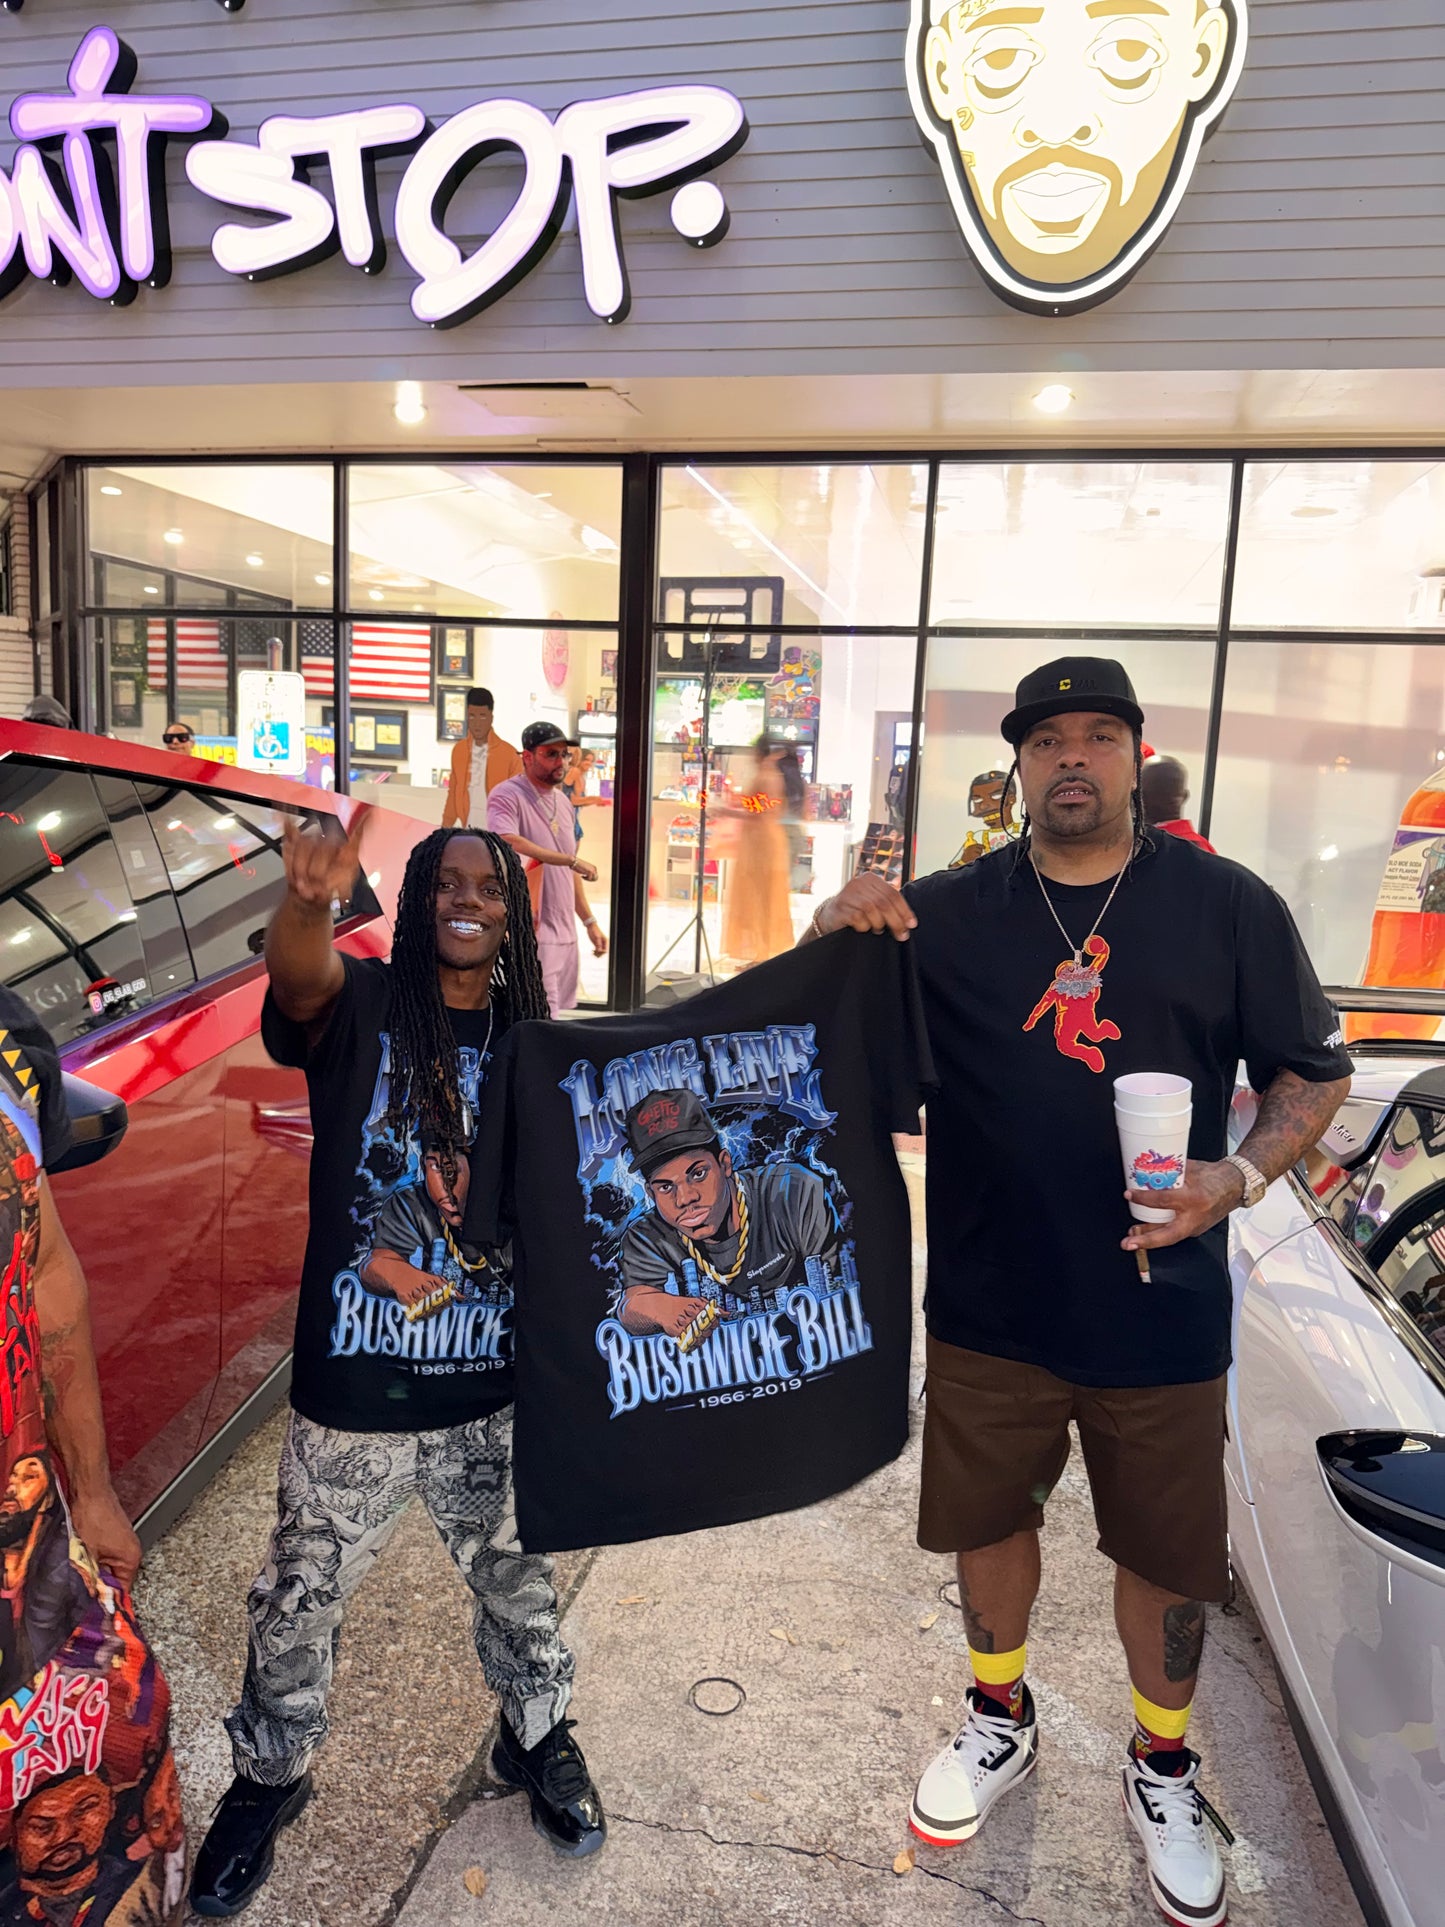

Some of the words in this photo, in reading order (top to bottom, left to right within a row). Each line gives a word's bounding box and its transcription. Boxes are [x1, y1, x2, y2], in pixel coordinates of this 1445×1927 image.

[185, 84, 746, 322] STOP.
[558, 1037, 708, 1181] LONG
[703, 1023, 838, 1130] LIVE
[637, 1099, 681, 1126] GHETTO
[328, 1270, 513, 1361] BUSHWICK
[595, 1311, 799, 1420] BUSHWICK
[785, 1283, 875, 1378] BILL
[412, 1360, 506, 1376] 1966-2019
[698, 1378, 803, 1410] 1966-2019
